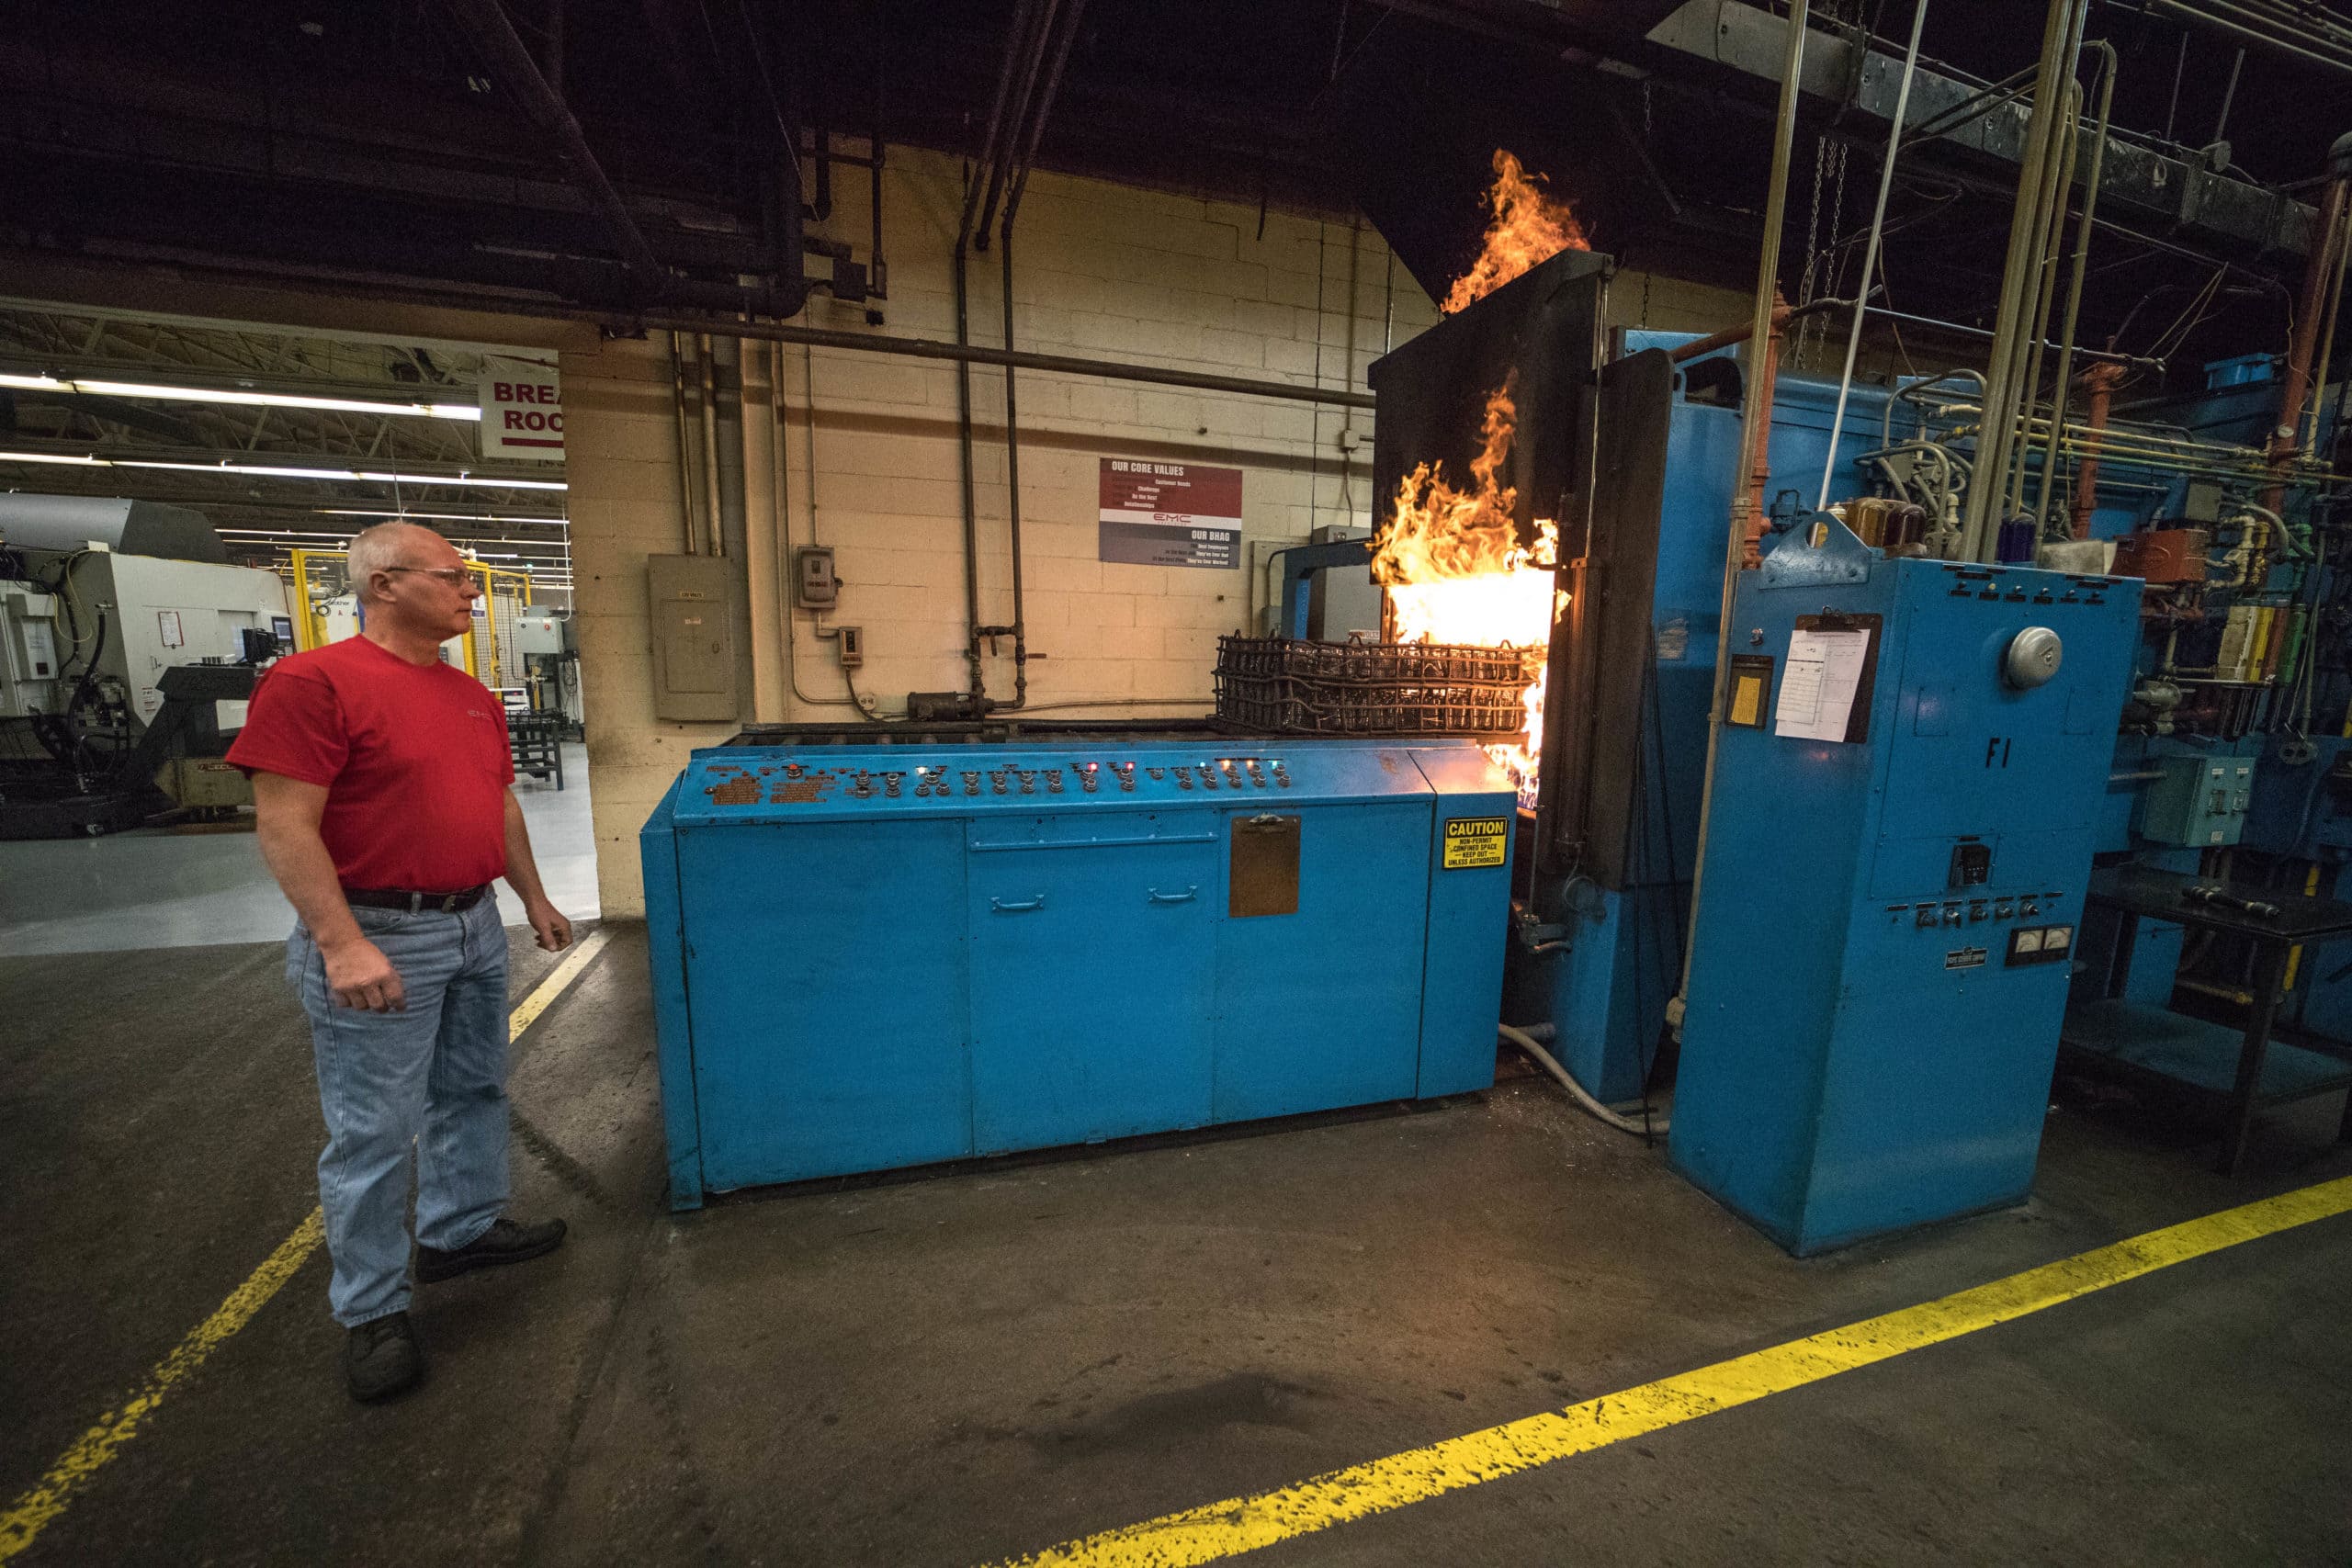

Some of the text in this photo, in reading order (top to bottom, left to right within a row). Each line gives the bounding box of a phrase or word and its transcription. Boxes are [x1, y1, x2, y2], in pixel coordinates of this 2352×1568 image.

[494, 382, 561, 404] BRE
[1112, 461, 1184, 477] OUR CORE VALUES
[1153, 513, 1192, 524] EMC
[1192, 529, 1230, 542] OUR BHAG
[1449, 822, 1503, 836] CAUTION
[1453, 844, 1479, 852] CONFINED
[1448, 856, 1500, 866] UNLESS AUTHORIZED
